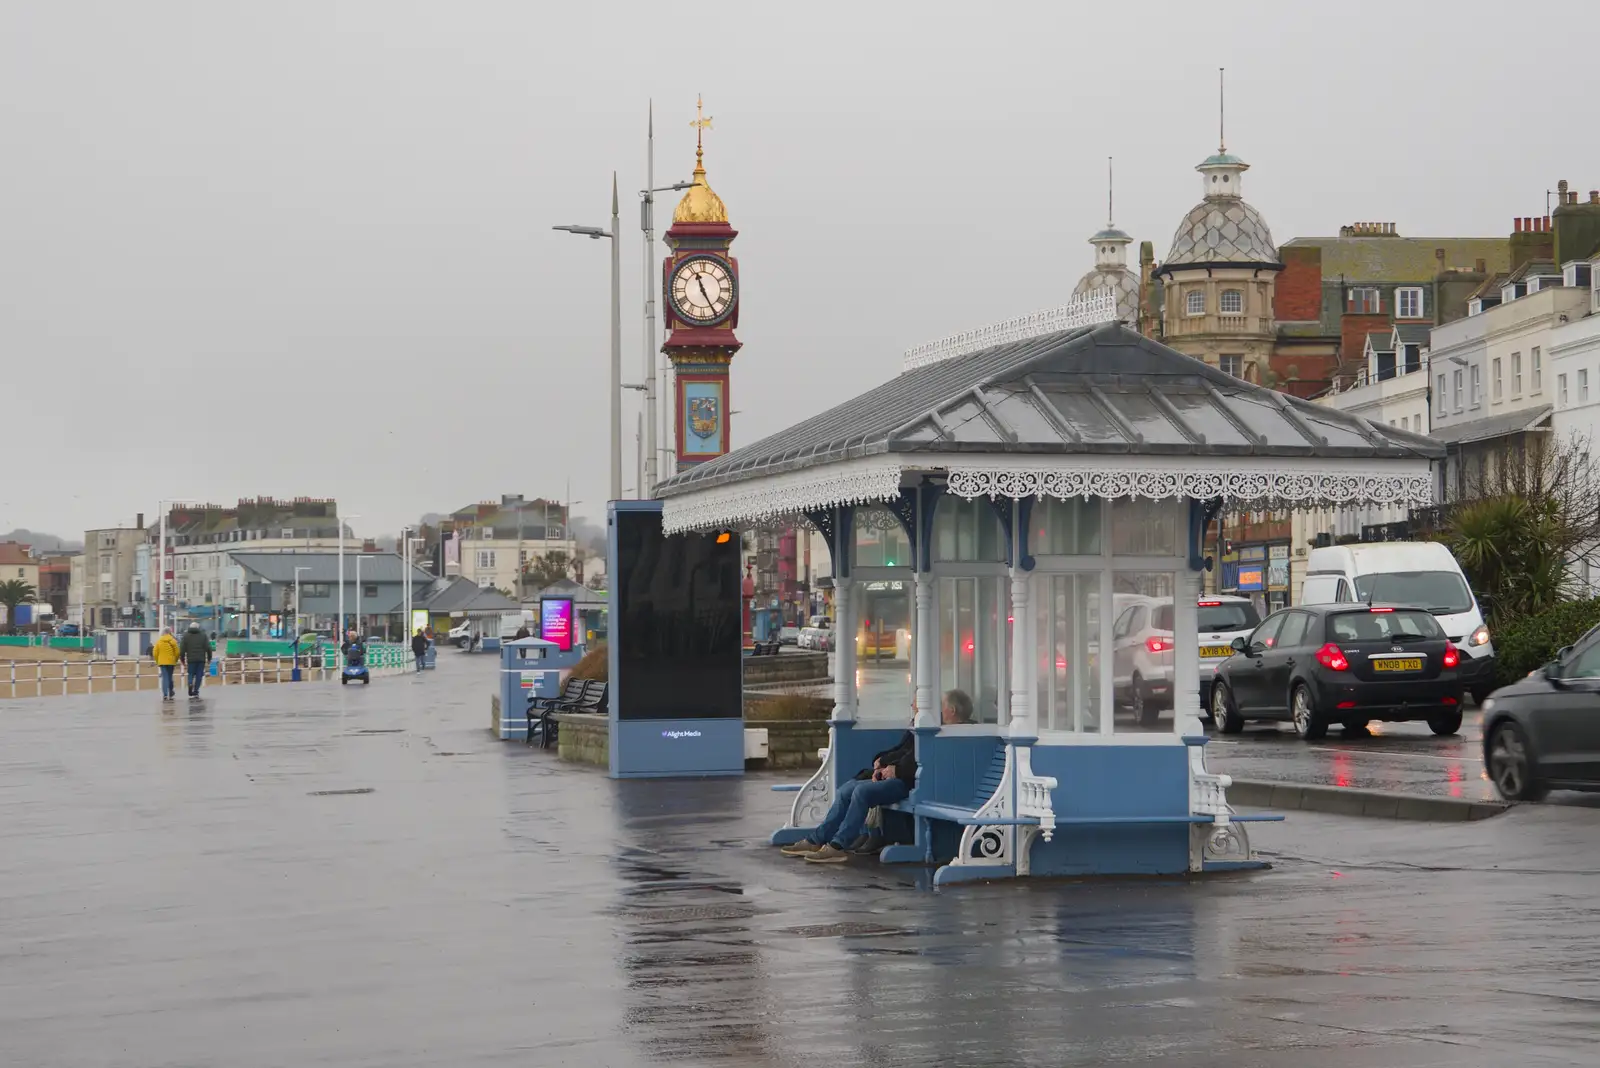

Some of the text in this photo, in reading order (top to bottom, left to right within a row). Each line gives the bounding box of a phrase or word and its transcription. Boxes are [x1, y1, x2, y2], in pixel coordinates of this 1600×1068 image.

[1202, 647, 1219, 656] AY18
[1378, 660, 1400, 669] WN08
[667, 730, 684, 739] Alight
